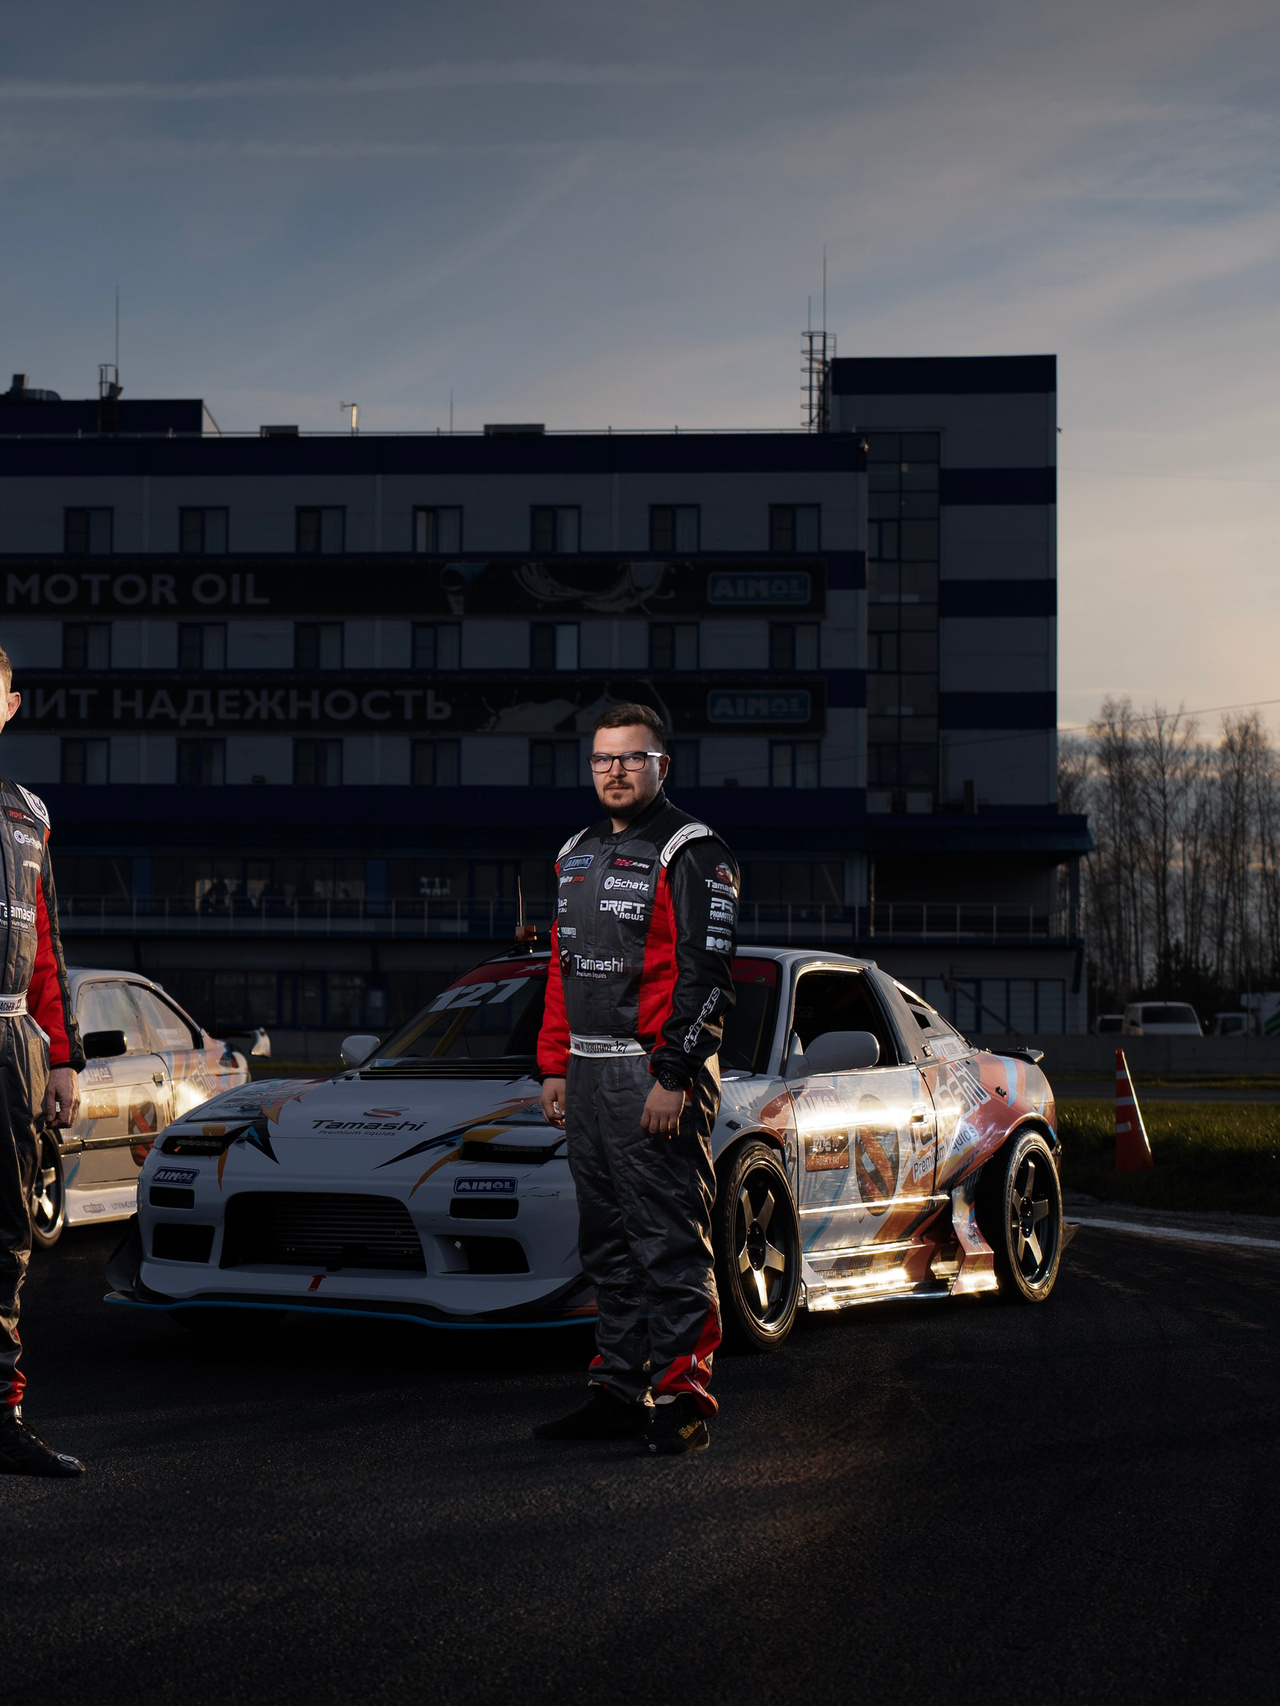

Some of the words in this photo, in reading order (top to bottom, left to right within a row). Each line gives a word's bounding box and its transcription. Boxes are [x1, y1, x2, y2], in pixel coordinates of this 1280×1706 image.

[6, 572, 178, 606] MOTOR
[190, 572, 270, 606] OIL
[712, 579, 805, 598] AIMOL
[112, 687, 453, 728] НАДЕЖНОСТЬ
[712, 697, 805, 716] AIMOL
[613, 878, 650, 892] Schatz
[619, 911, 645, 922] news
[573, 954, 624, 973] Tamashi
[427, 976, 531, 1013] 127
[614, 1040, 628, 1054] 127
[311, 1120, 428, 1132] Tamashi
[154, 1171, 195, 1182] AIMOL
[457, 1181, 515, 1191] AIMOL
